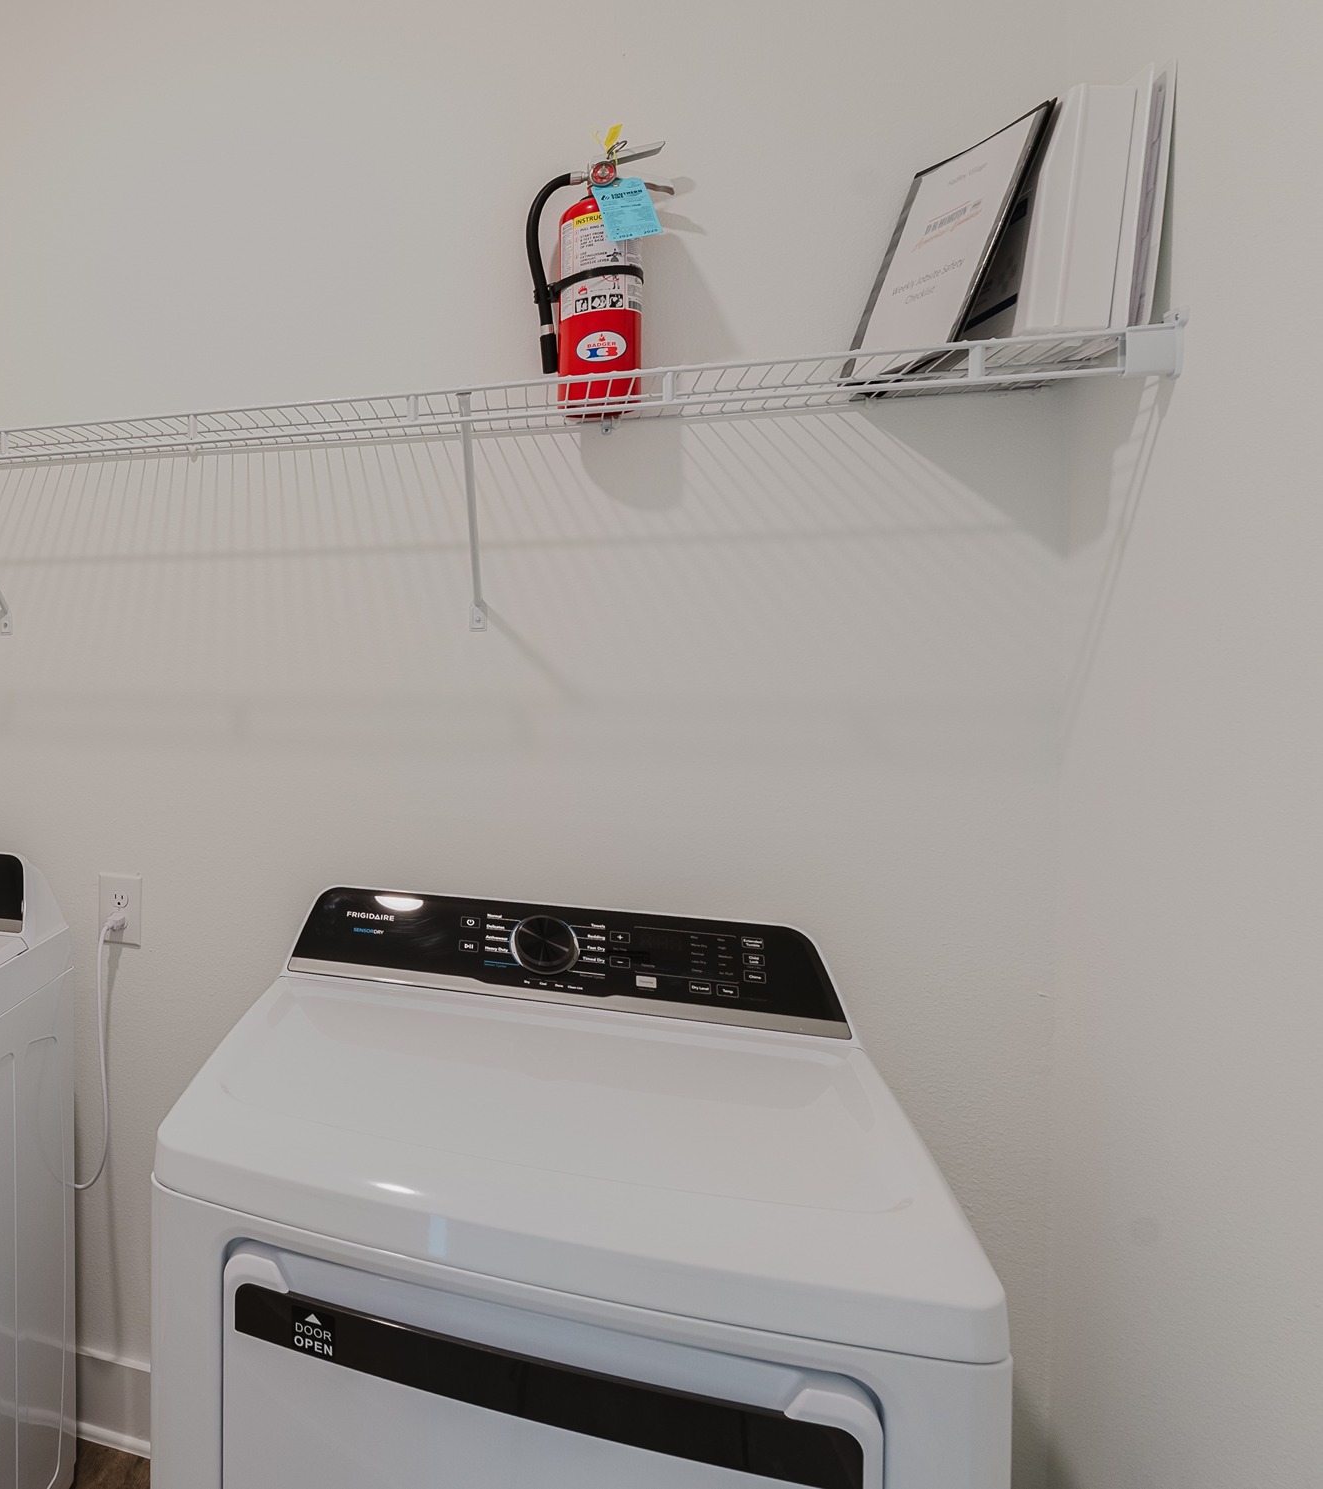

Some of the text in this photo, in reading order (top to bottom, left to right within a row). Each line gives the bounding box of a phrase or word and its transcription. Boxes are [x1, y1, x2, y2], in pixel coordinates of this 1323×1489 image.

[576, 215, 602, 225] INSTRUC
[347, 911, 394, 921] FRIGIDAIRE
[295, 1321, 332, 1342] DOOR
[293, 1335, 333, 1356] OPEN
